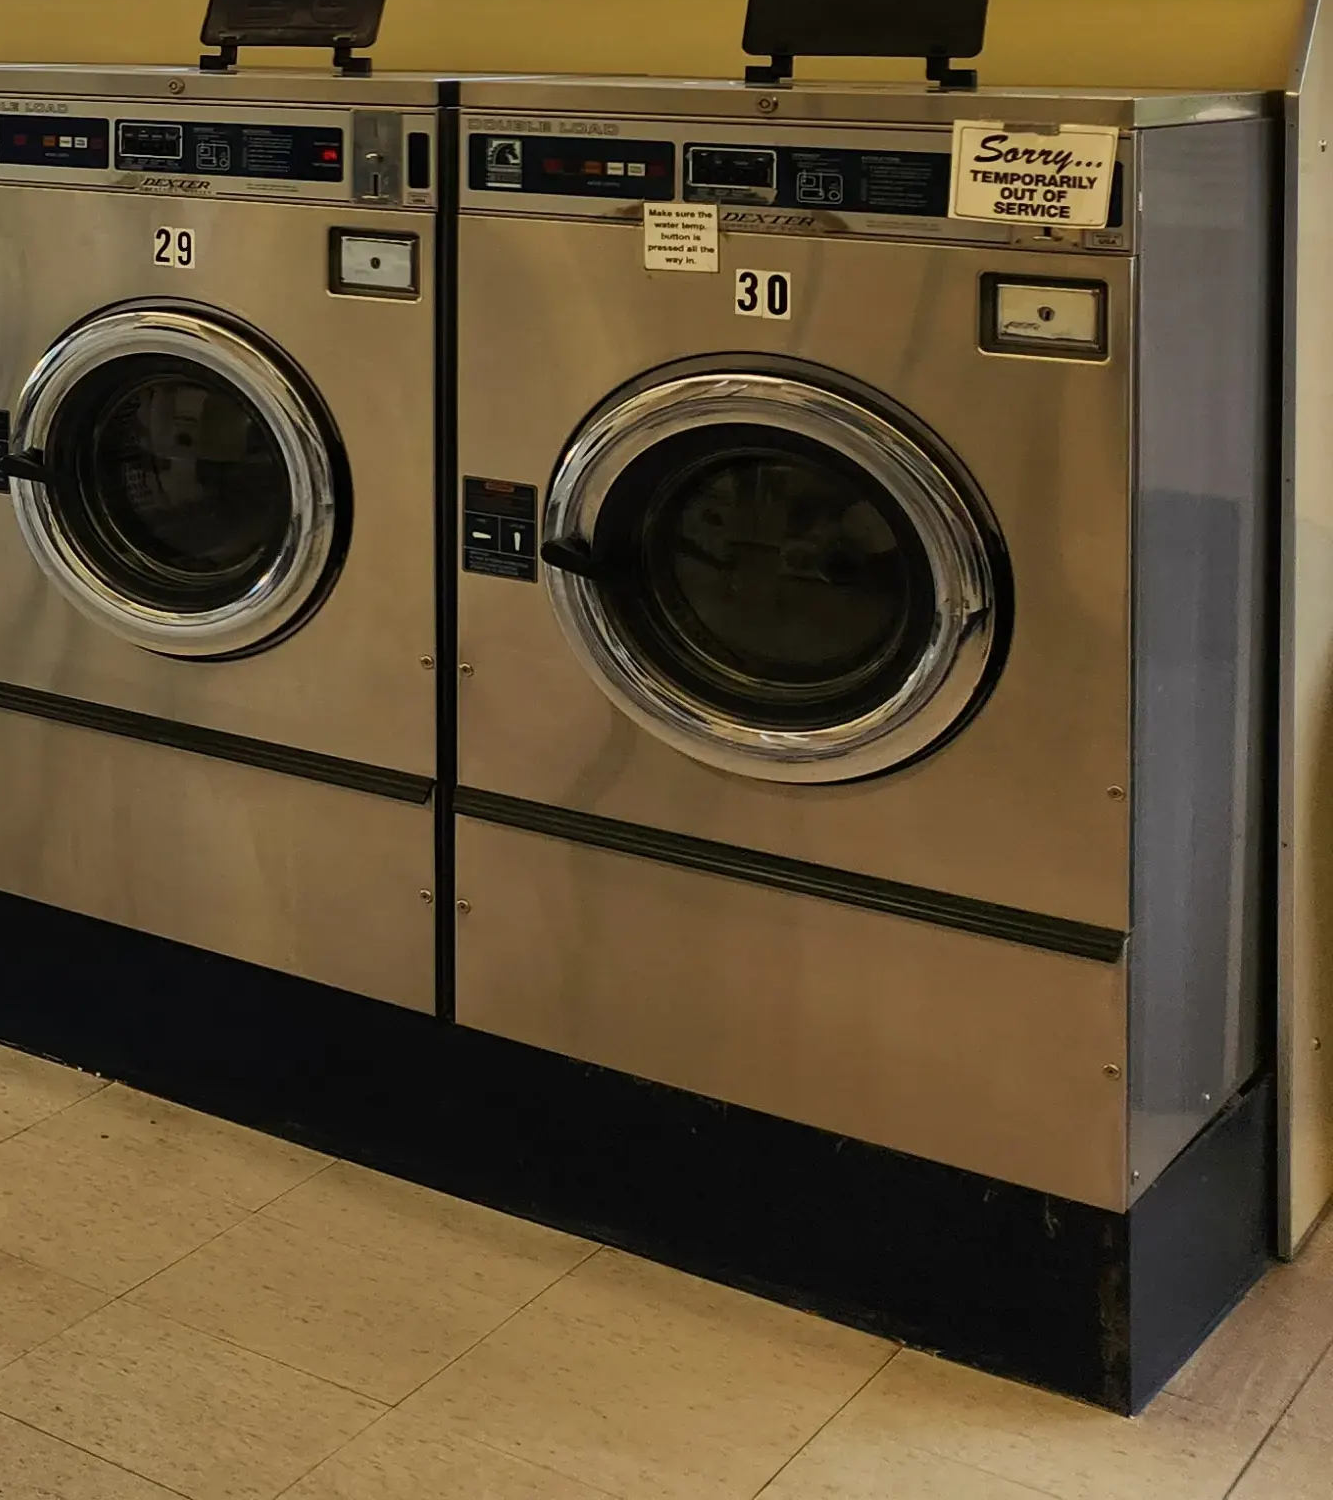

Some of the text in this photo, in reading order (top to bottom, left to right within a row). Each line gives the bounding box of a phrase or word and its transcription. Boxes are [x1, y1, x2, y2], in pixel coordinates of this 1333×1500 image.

[25, 102, 69, 114] LOAD
[467, 118, 620, 136] DOUBLE LOAD
[973, 134, 1103, 175] Sorry...
[141, 177, 211, 190] DEXTER
[970, 169, 1098, 189] TEMPORARILY
[1000, 186, 1068, 203] OUT OF
[648, 208, 713, 219] Make sure the
[993, 201, 1071, 219] SERVICE
[654, 221, 707, 232] water temp.
[721, 211, 817, 227] DEXTER
[660, 232, 701, 242] button is
[154, 228, 193, 266] 29
[647, 243, 715, 254] pressed all the
[665, 255, 697, 266] way in.
[736, 271, 788, 316] 30
